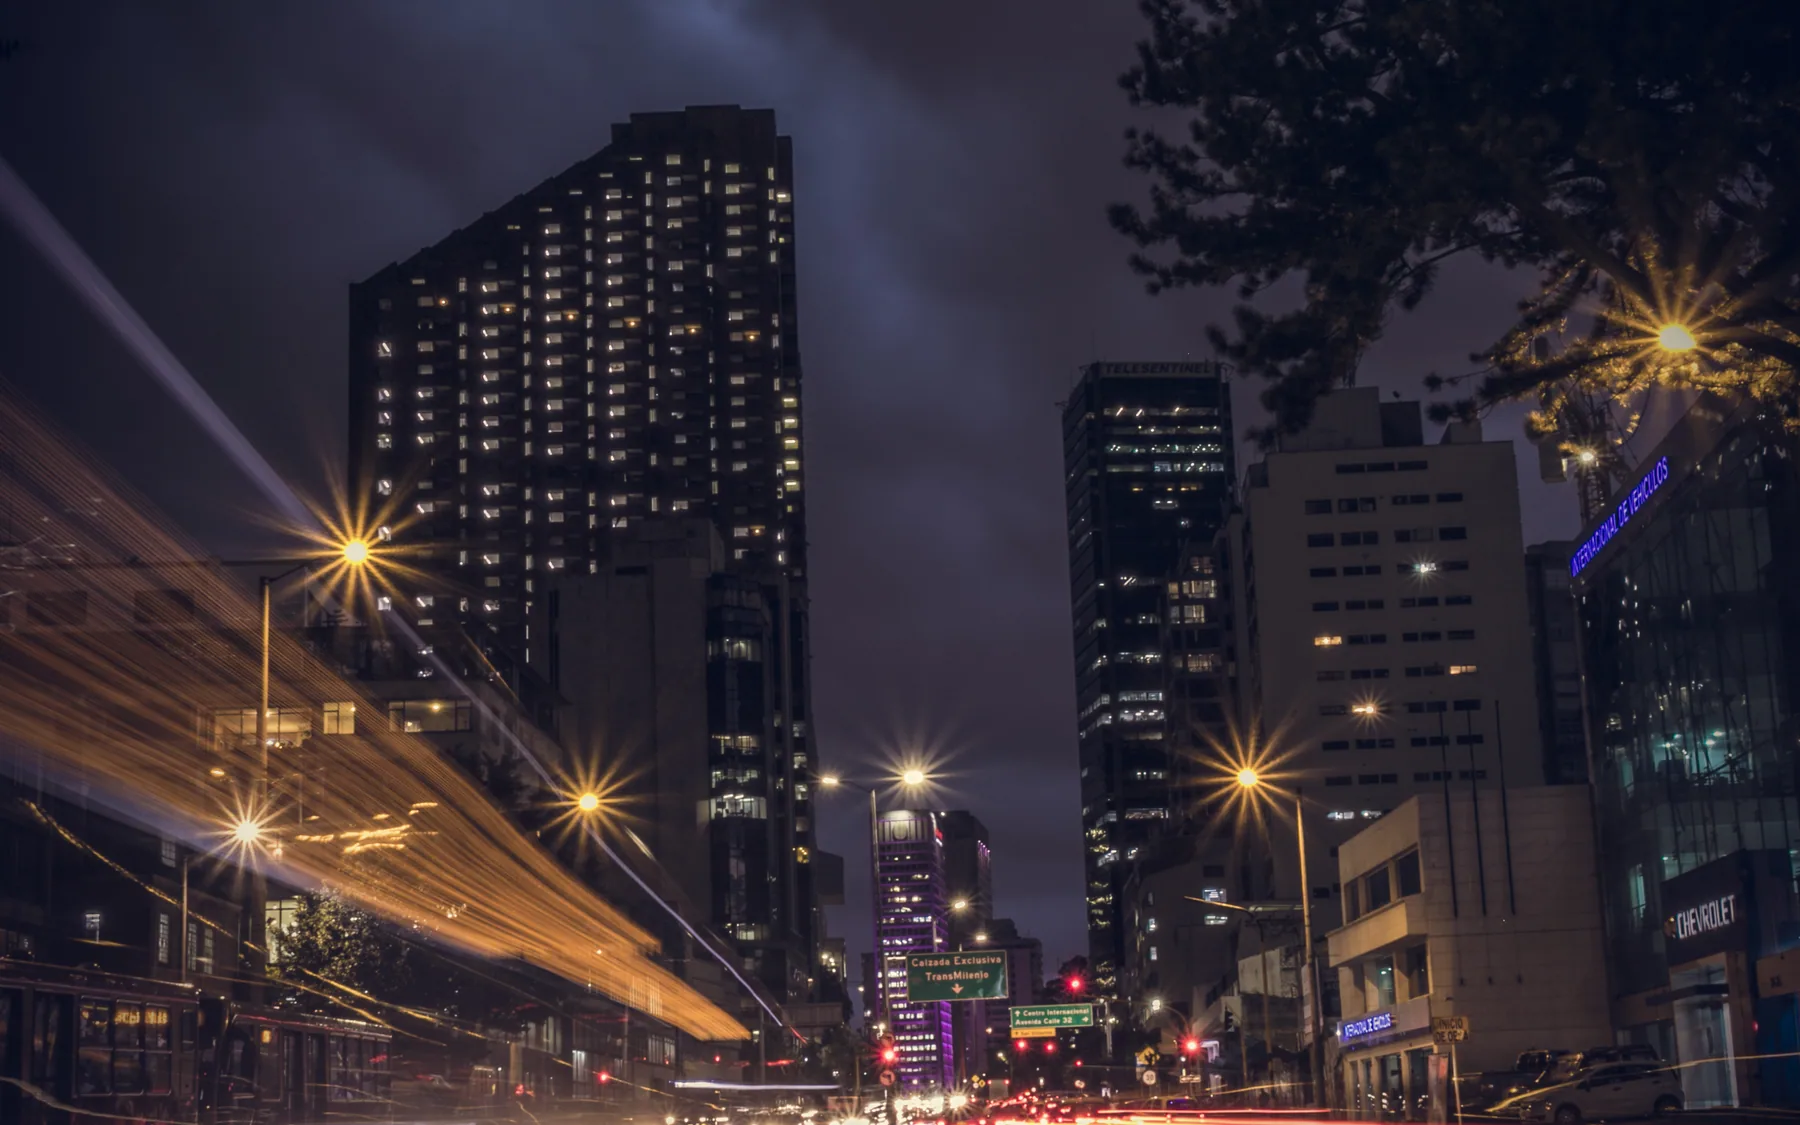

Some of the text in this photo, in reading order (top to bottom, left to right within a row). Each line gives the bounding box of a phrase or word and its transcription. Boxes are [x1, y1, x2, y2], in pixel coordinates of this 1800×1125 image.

[1105, 363, 1211, 374] TELESENTINEL
[1618, 500, 1629, 527] DE
[1628, 456, 1668, 515] VEHICULOS
[1677, 895, 1735, 939] CHEVROLET
[911, 955, 1002, 967] Calzada Exclusiva
[925, 970, 989, 981] TransMilenio
[1047, 1008, 1089, 1016] Internacional
[1062, 1016, 1073, 1024] 32
